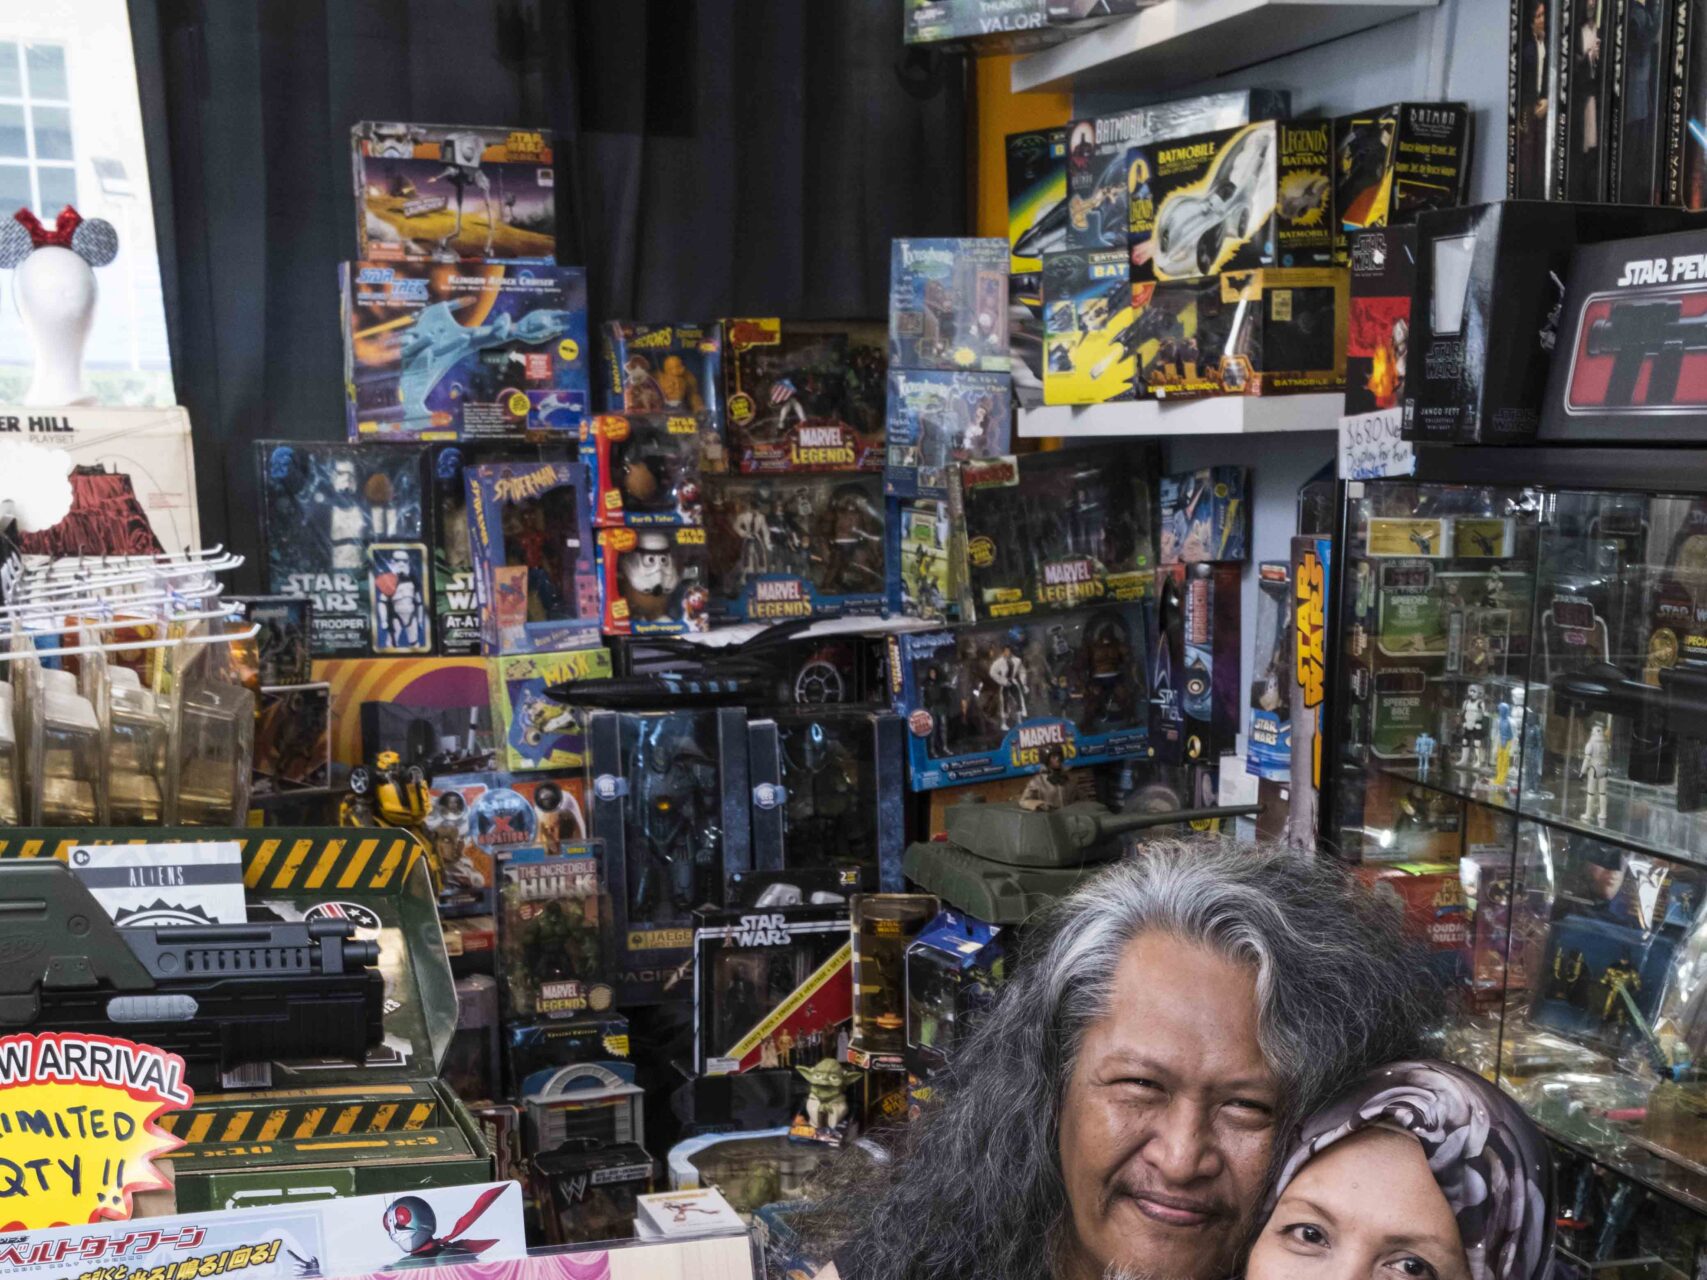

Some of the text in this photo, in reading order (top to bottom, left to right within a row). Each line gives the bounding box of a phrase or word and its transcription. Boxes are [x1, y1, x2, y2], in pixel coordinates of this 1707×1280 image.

[1158, 142, 1215, 165] BATMOBILE
[1670, 155, 1680, 201] VADE
[1617, 258, 1669, 287] STAR
[28, 416, 75, 432] HILL
[800, 427, 843, 447] MARVEL
[791, 442, 856, 464] LEGENDS
[280, 573, 475, 591] STAR ST
[1045, 562, 1091, 584] MARVEL
[757, 582, 801, 600] MARVEL
[1037, 576, 1105, 603] LEGENDS
[312, 594, 360, 612] ARS
[748, 595, 813, 618] LEGENDS
[1254, 719, 1278, 732] STAR
[1019, 725, 1065, 748] MARVEL
[129, 866, 185, 887] ALIENS
[519, 861, 595, 877] THE INCREDIBLE
[519, 875, 594, 898] HULK
[740, 914, 786, 931] STAR
[652, 929, 692, 941] JAEGE
[734, 930, 791, 947] WARS
[542, 983, 577, 999] MARVEL
[536, 996, 587, 1014] LEGENDS
[38, 1043, 186, 1101] ARRIVAL
[0, 1105, 136, 1142] IMITED
[0, 1154, 81, 1198] QTY
